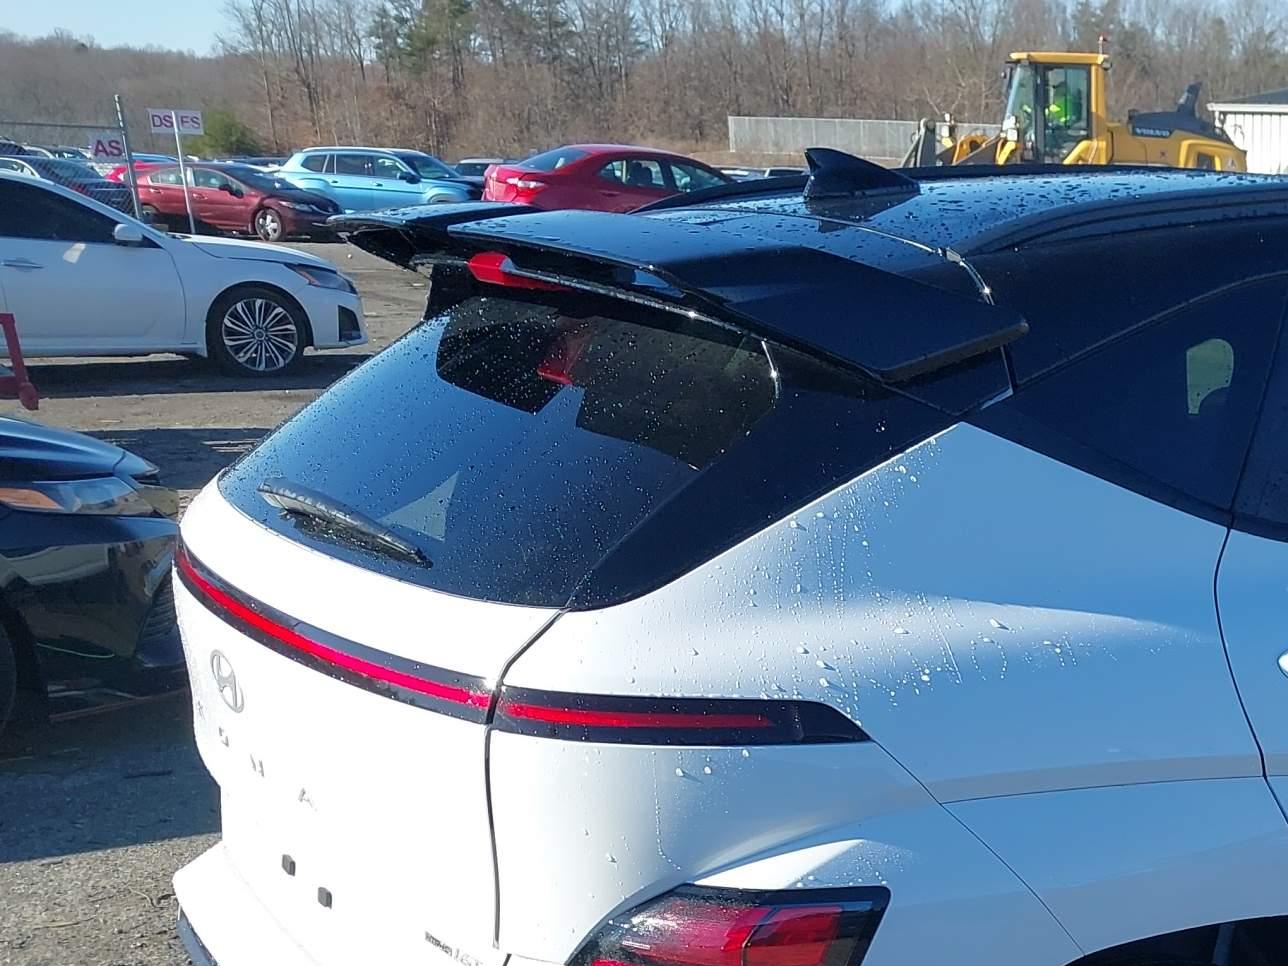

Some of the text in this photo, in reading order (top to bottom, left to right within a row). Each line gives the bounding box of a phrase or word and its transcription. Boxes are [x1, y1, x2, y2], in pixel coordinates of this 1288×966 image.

[151, 114, 173, 128] DS
[181, 115, 200, 129] FS
[94, 139, 123, 157] AS
